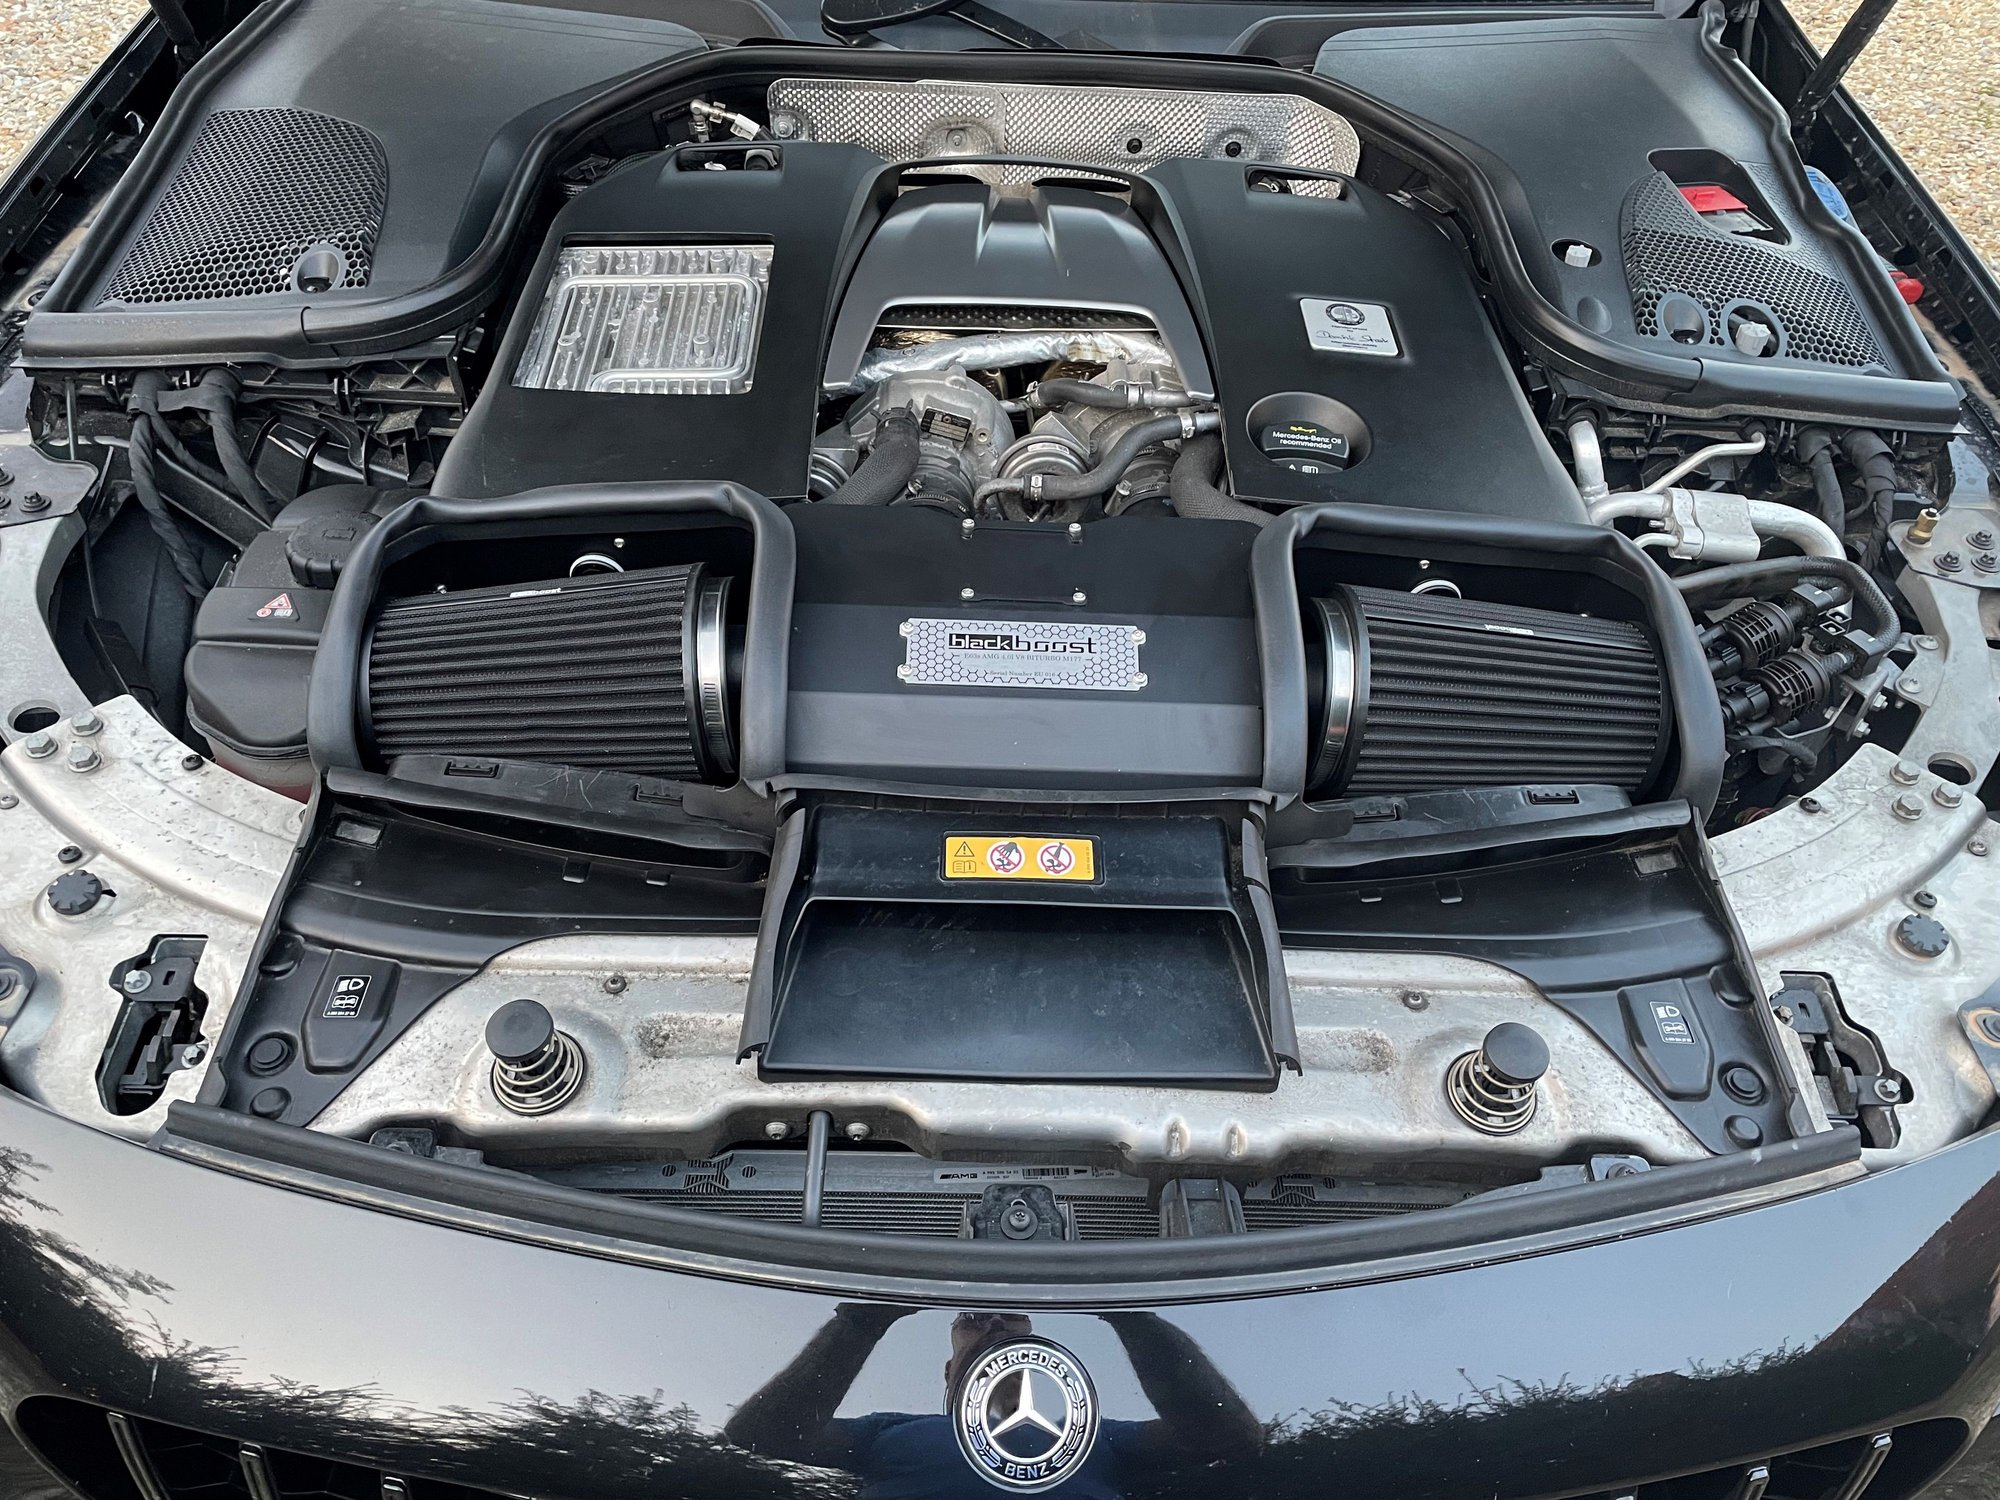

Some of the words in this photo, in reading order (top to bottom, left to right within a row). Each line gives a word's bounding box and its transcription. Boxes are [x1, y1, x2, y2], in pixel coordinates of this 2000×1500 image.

[1272, 431, 1330, 443] Mercedes-Benz
[1280, 439, 1332, 449] recommended
[984, 1350, 1068, 1378] MERCEDES
[1004, 1462, 1050, 1479] BENZ
